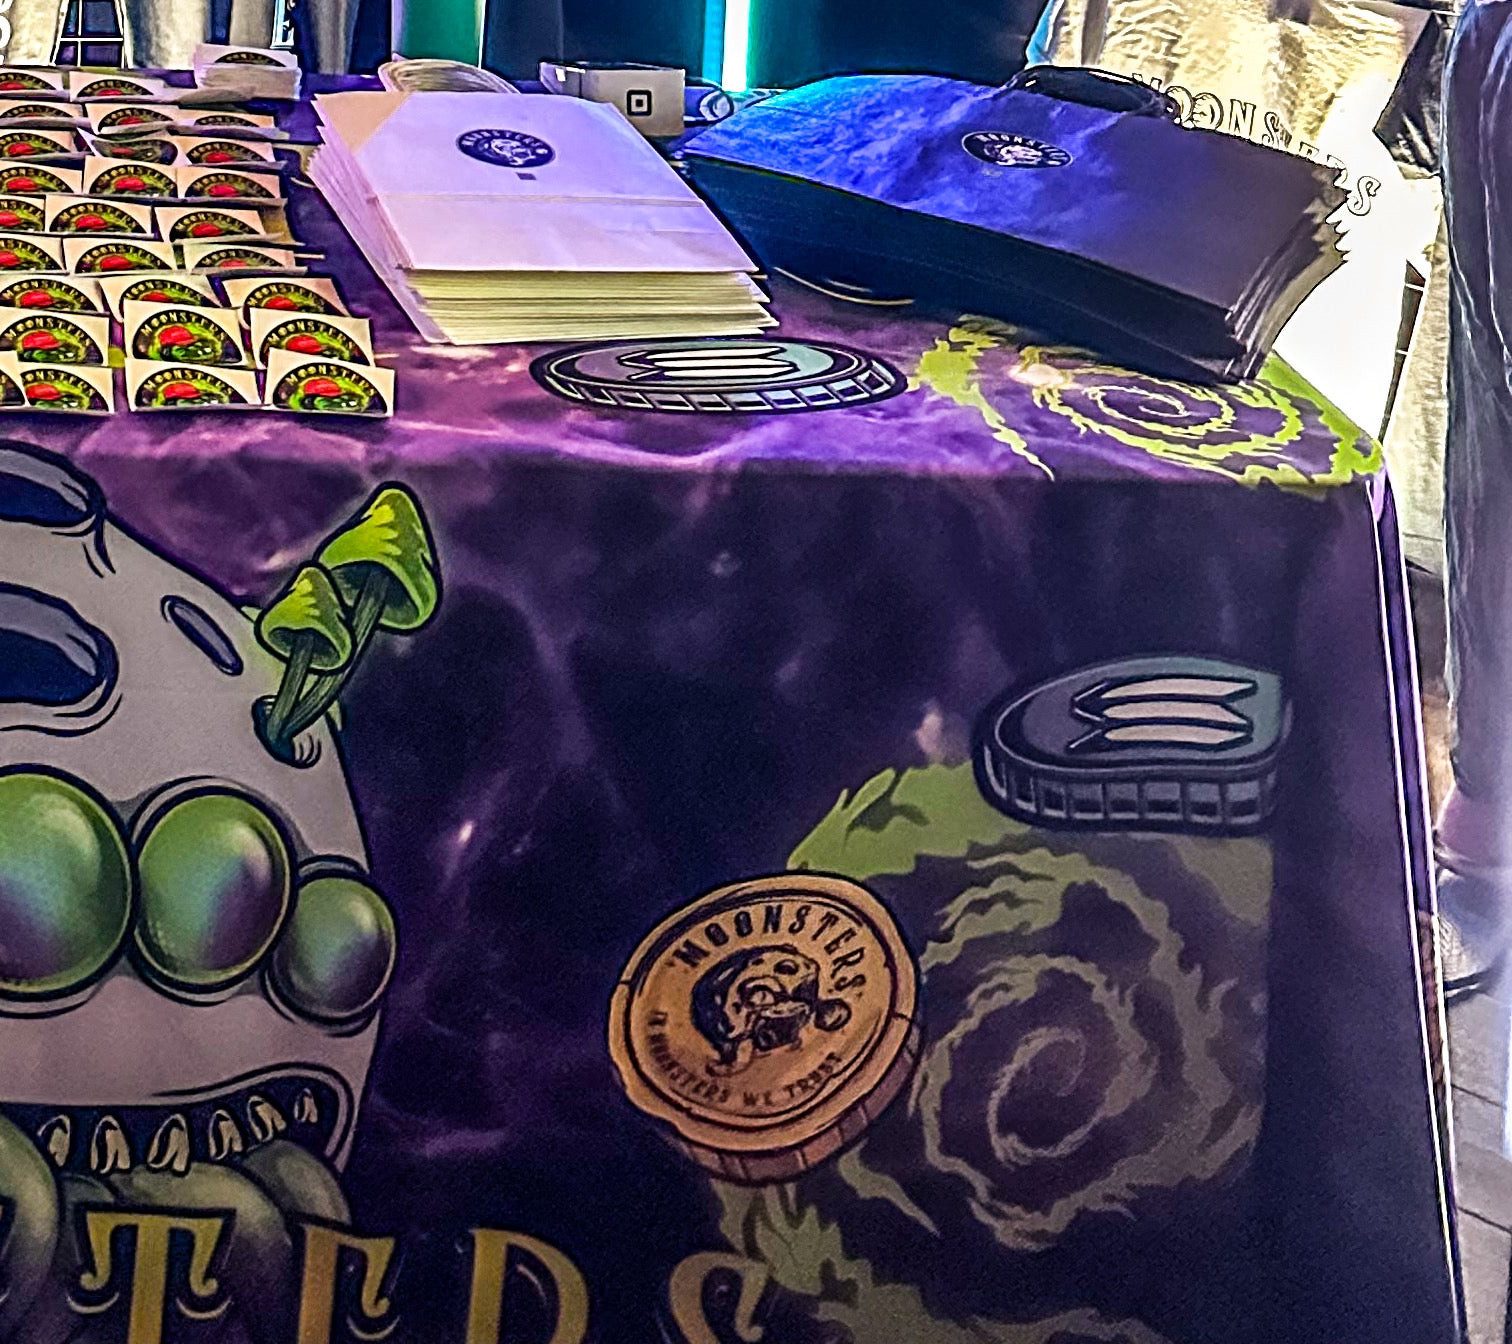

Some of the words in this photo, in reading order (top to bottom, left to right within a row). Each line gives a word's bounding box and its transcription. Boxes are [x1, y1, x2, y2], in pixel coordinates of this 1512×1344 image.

[4, 316, 93, 346] MOONSTERS
[140, 312, 226, 342] MOONSTERS
[143, 370, 233, 396] MOONSTERS
[285, 365, 376, 396] MOONSTERS
[672, 904, 866, 993] MOONSTERS
[744, 1092, 774, 1106] WE
